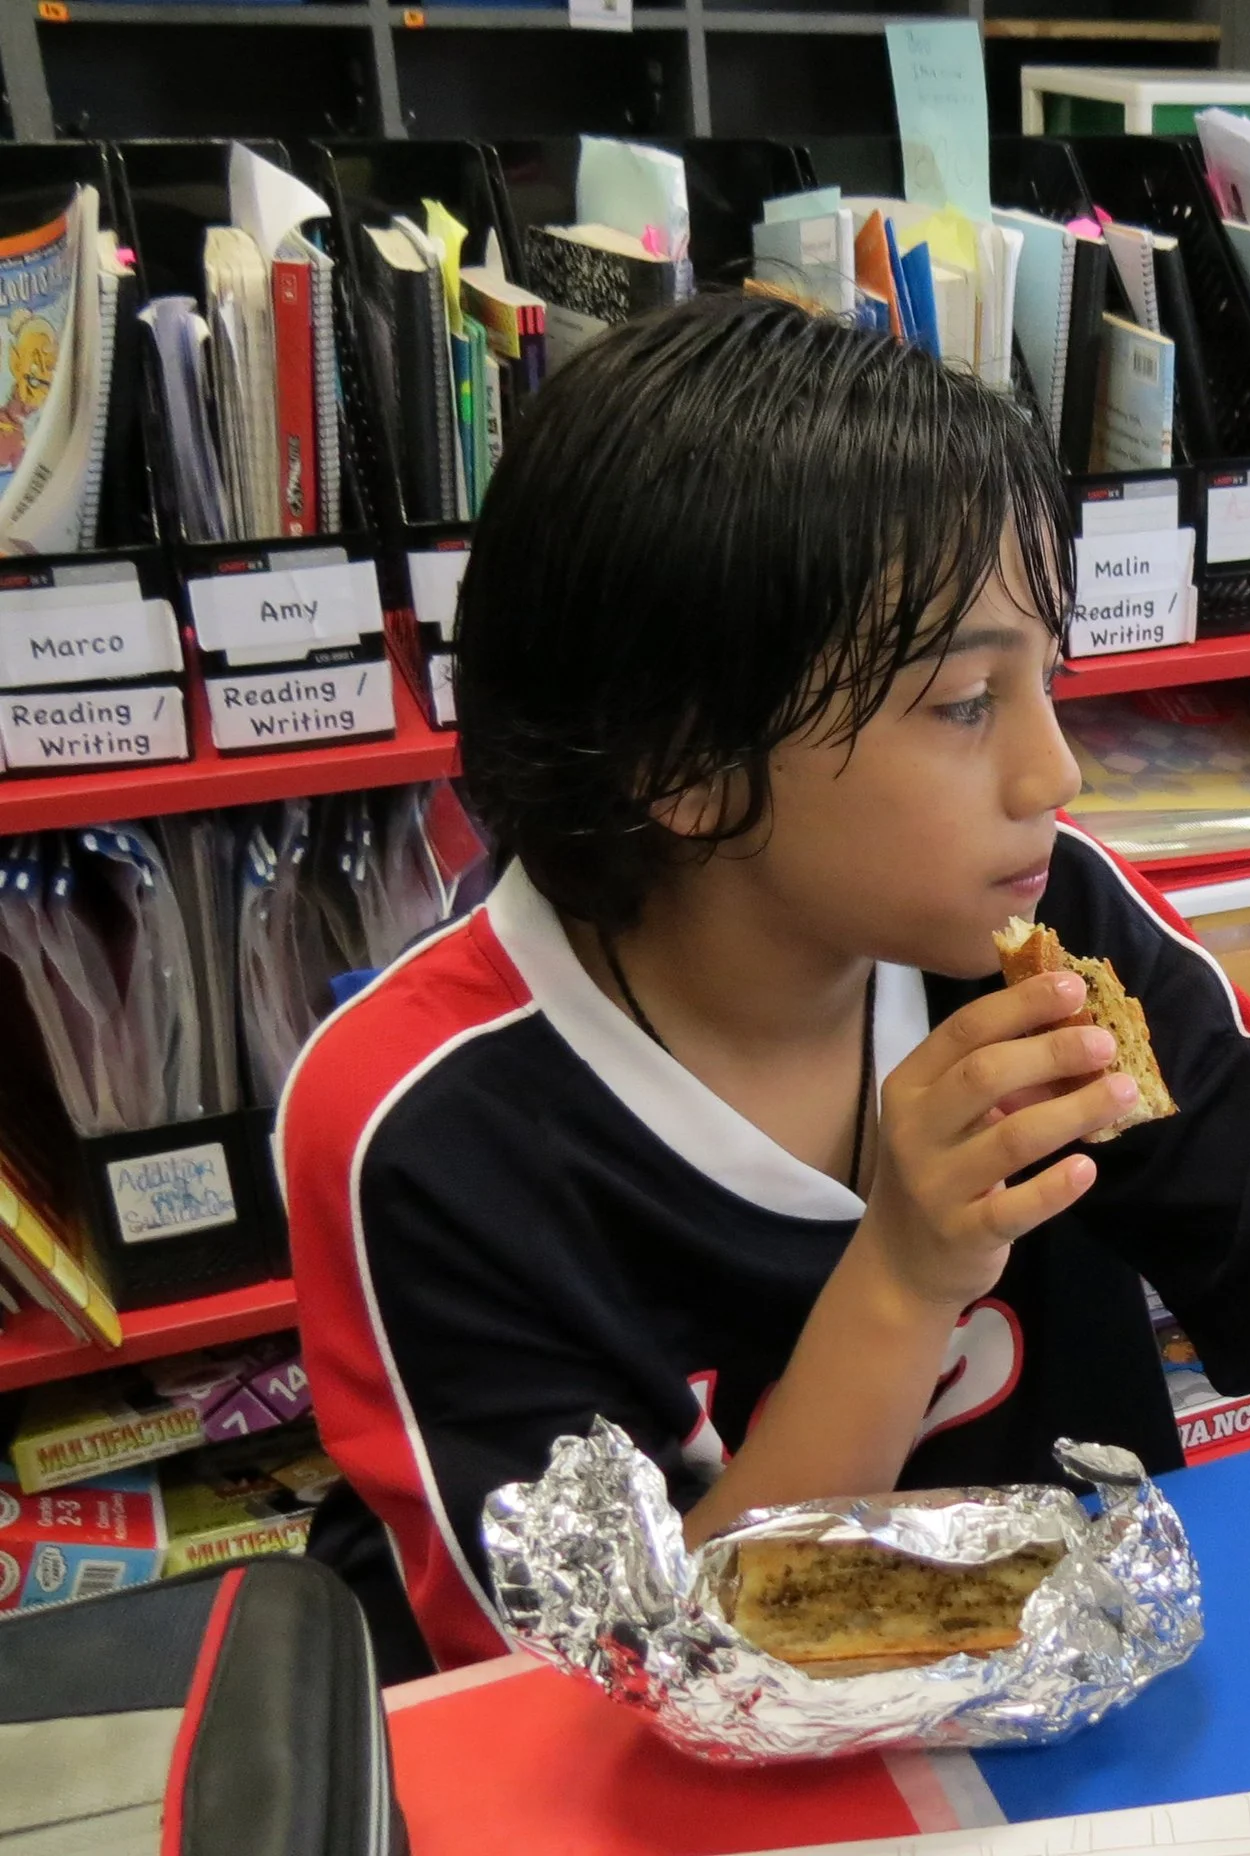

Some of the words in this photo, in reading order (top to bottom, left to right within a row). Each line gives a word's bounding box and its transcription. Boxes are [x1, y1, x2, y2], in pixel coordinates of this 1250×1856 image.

[1095, 557, 1151, 579] Malin
[260, 598, 320, 623] Amy
[1073, 598, 1155, 623] Reading
[1168, 593, 1179, 614] /
[30, 634, 125, 660] Marco
[1090, 623, 1164, 648] Writing
[223, 678, 337, 709] Reading
[356, 672, 368, 697] /
[12, 702, 131, 728] Reading
[152, 696, 165, 721] /
[250, 708, 356, 738] Writing
[40, 731, 151, 759] Writing
[268, 1363, 308, 1402] 14
[222, 1410, 250, 1435] 7
[56, 1499, 82, 1527] 2-3
